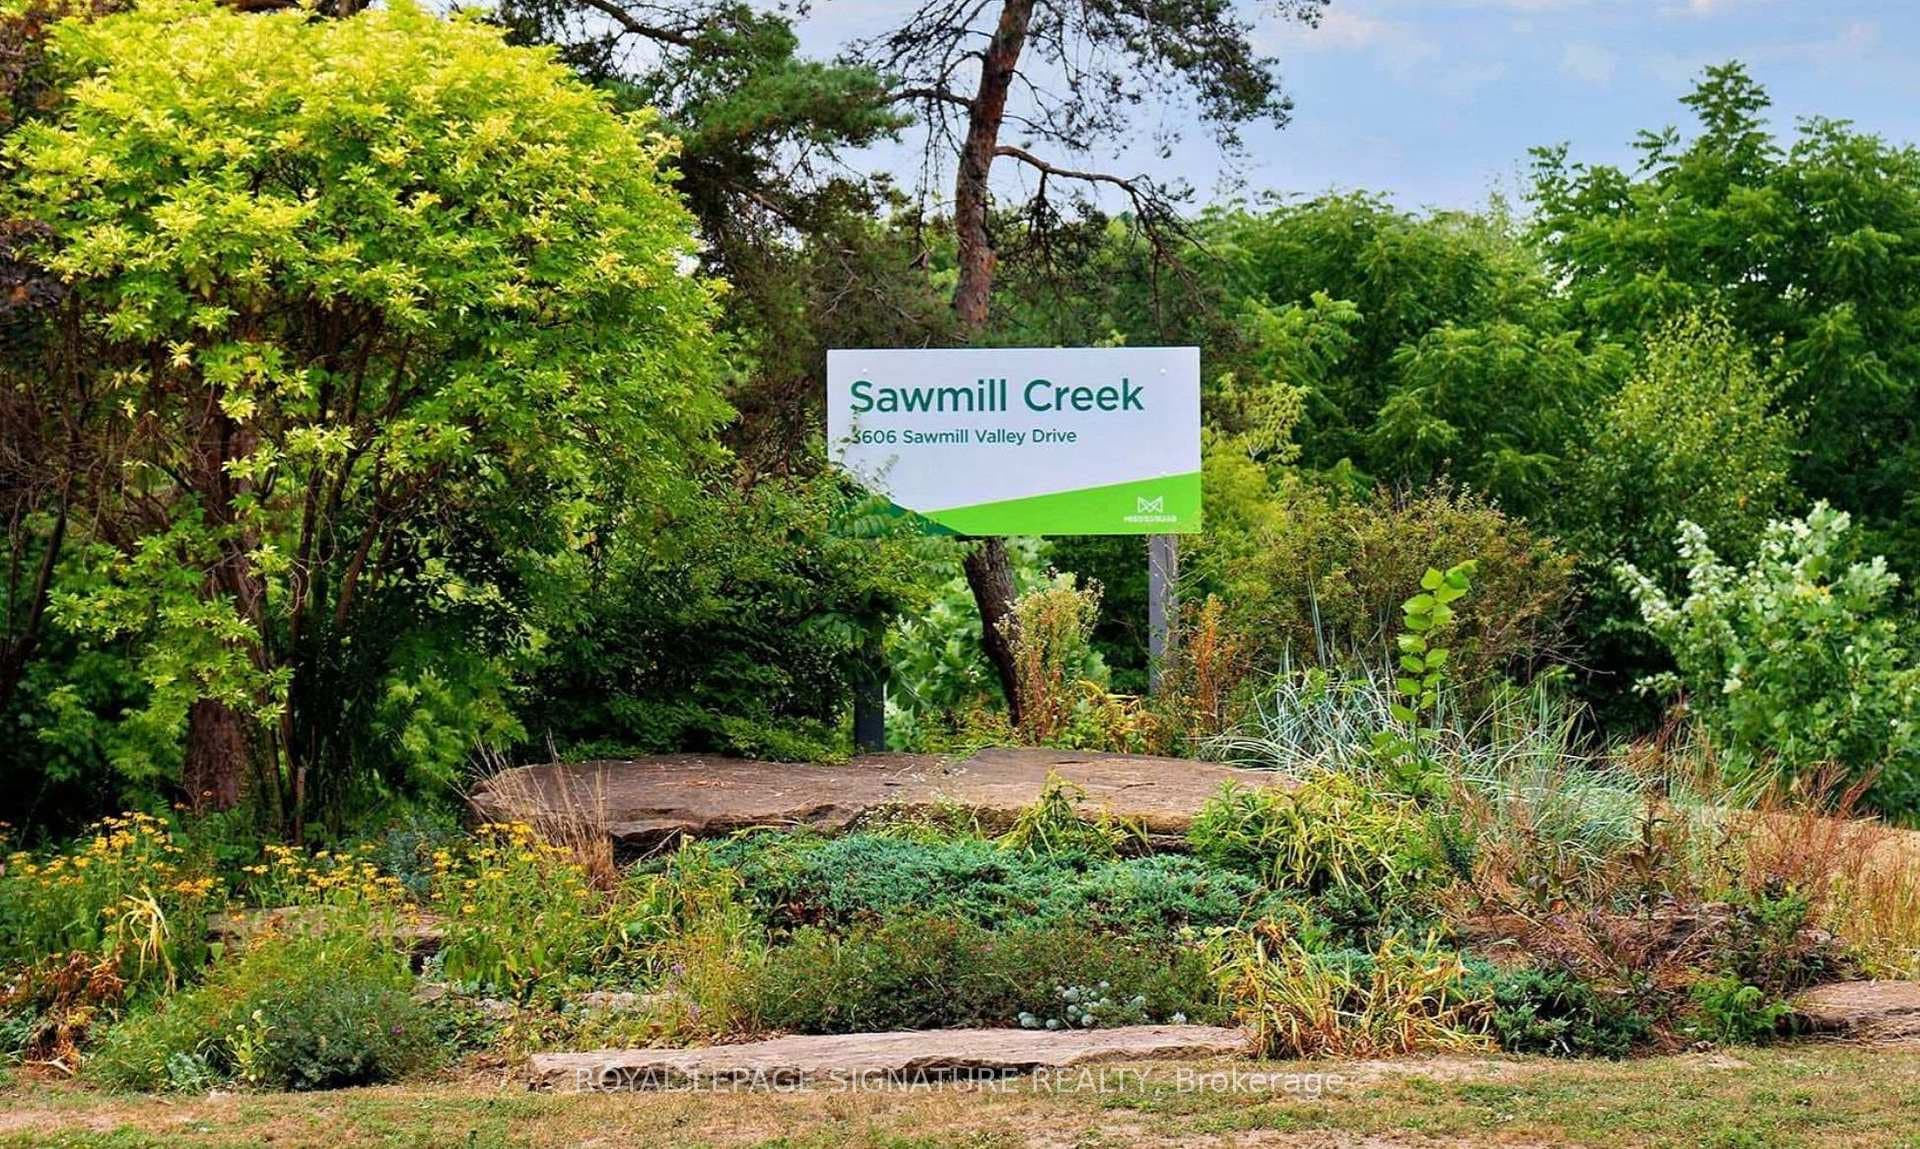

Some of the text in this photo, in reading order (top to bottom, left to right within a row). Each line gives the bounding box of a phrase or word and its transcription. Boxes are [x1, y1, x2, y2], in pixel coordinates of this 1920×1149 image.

[850, 377, 1144, 412] Sawmill Creek
[903, 428, 969, 444] Sawmill
[975, 429, 1026, 447] Valley
[1032, 428, 1077, 443] Drive
